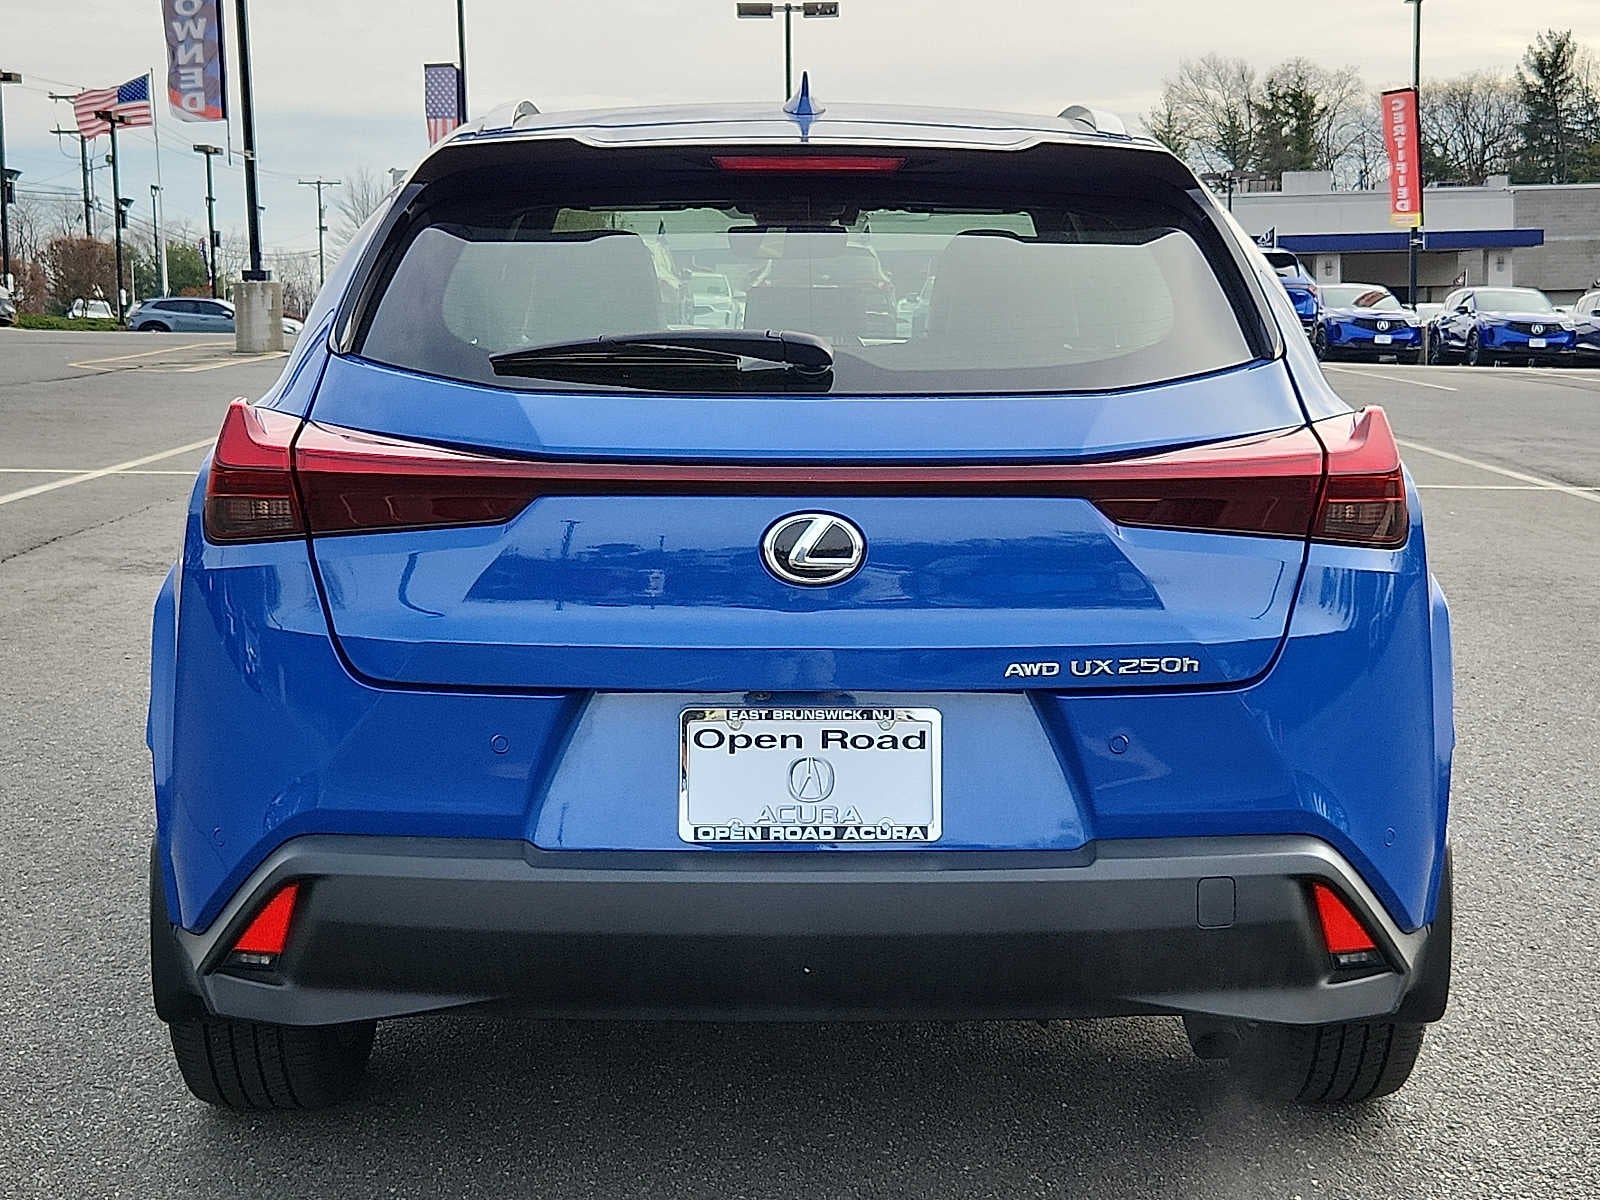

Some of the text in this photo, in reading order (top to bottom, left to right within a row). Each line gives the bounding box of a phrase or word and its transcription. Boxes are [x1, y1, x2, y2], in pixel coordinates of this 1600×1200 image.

[1004, 656, 1199, 677] AWD UX 250h
[728, 709, 893, 721] EAST BRUNSWICK, NJ
[693, 728, 926, 754] Open Road
[754, 805, 863, 824] ACURA
[697, 826, 925, 840] OPEN ROAD ACURA
